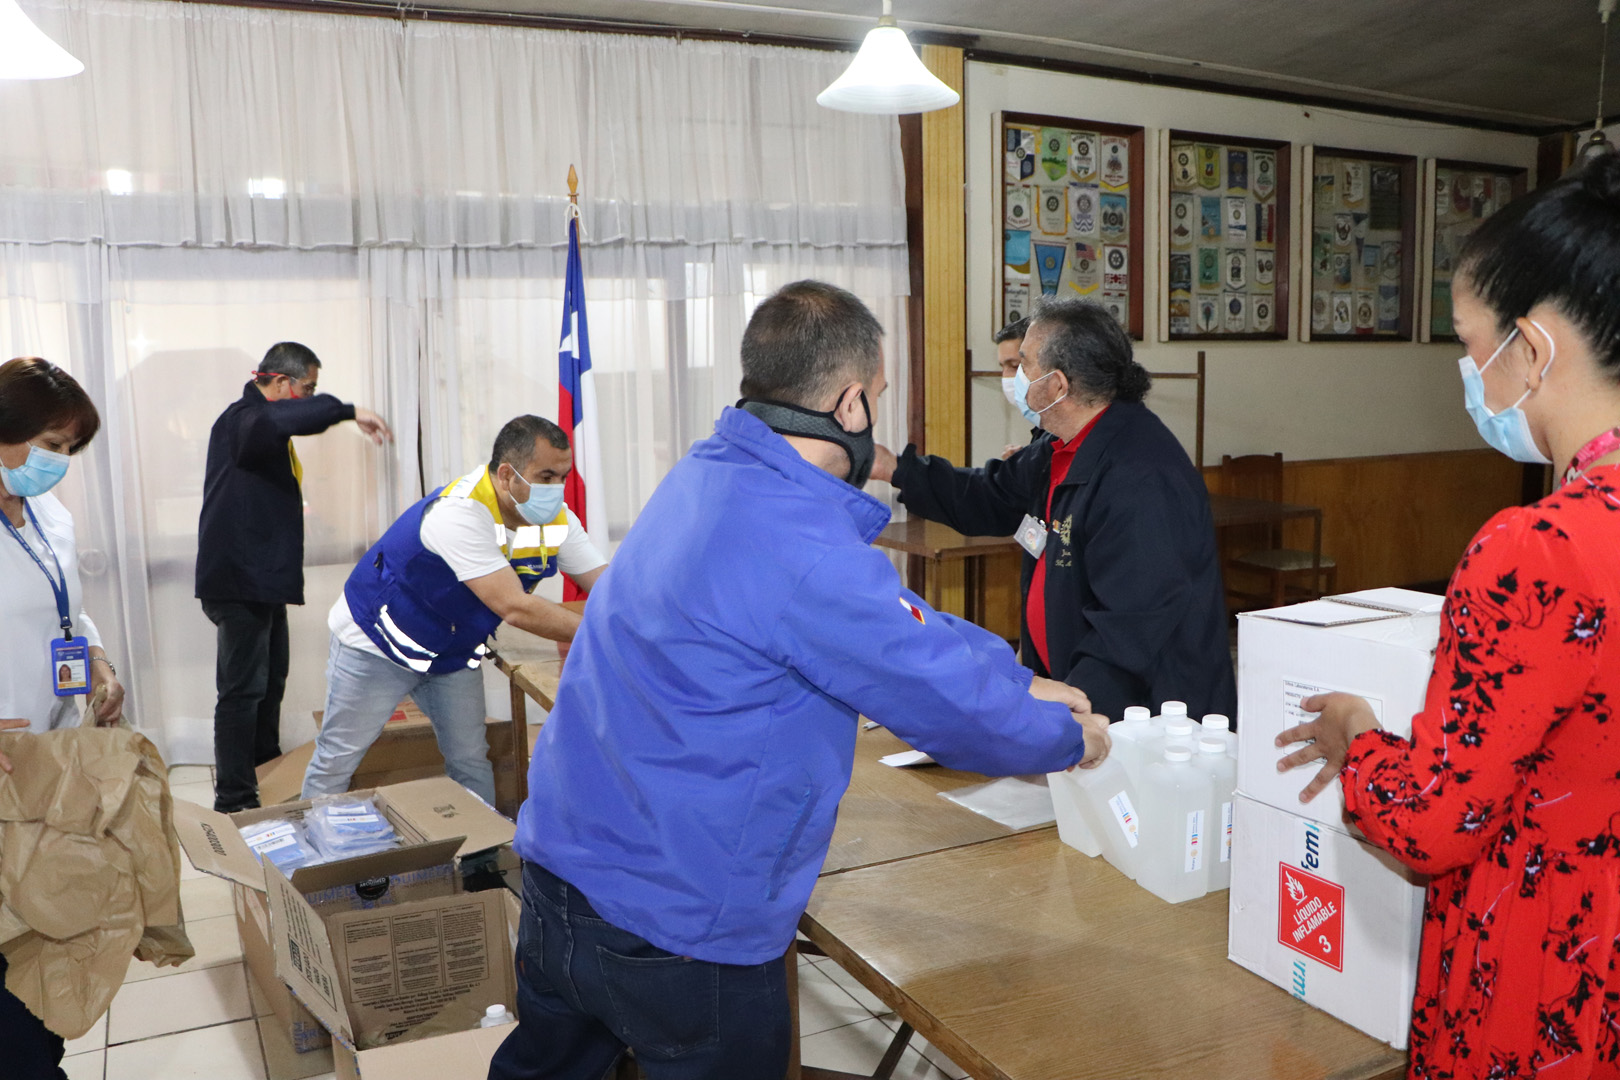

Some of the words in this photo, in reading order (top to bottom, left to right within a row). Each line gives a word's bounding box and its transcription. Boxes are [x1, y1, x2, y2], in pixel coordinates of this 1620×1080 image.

[1292, 901, 1338, 943] INFLAMABLE
[1293, 896, 1322, 925] LÍQUIDO
[1318, 934, 1332, 953] 3
